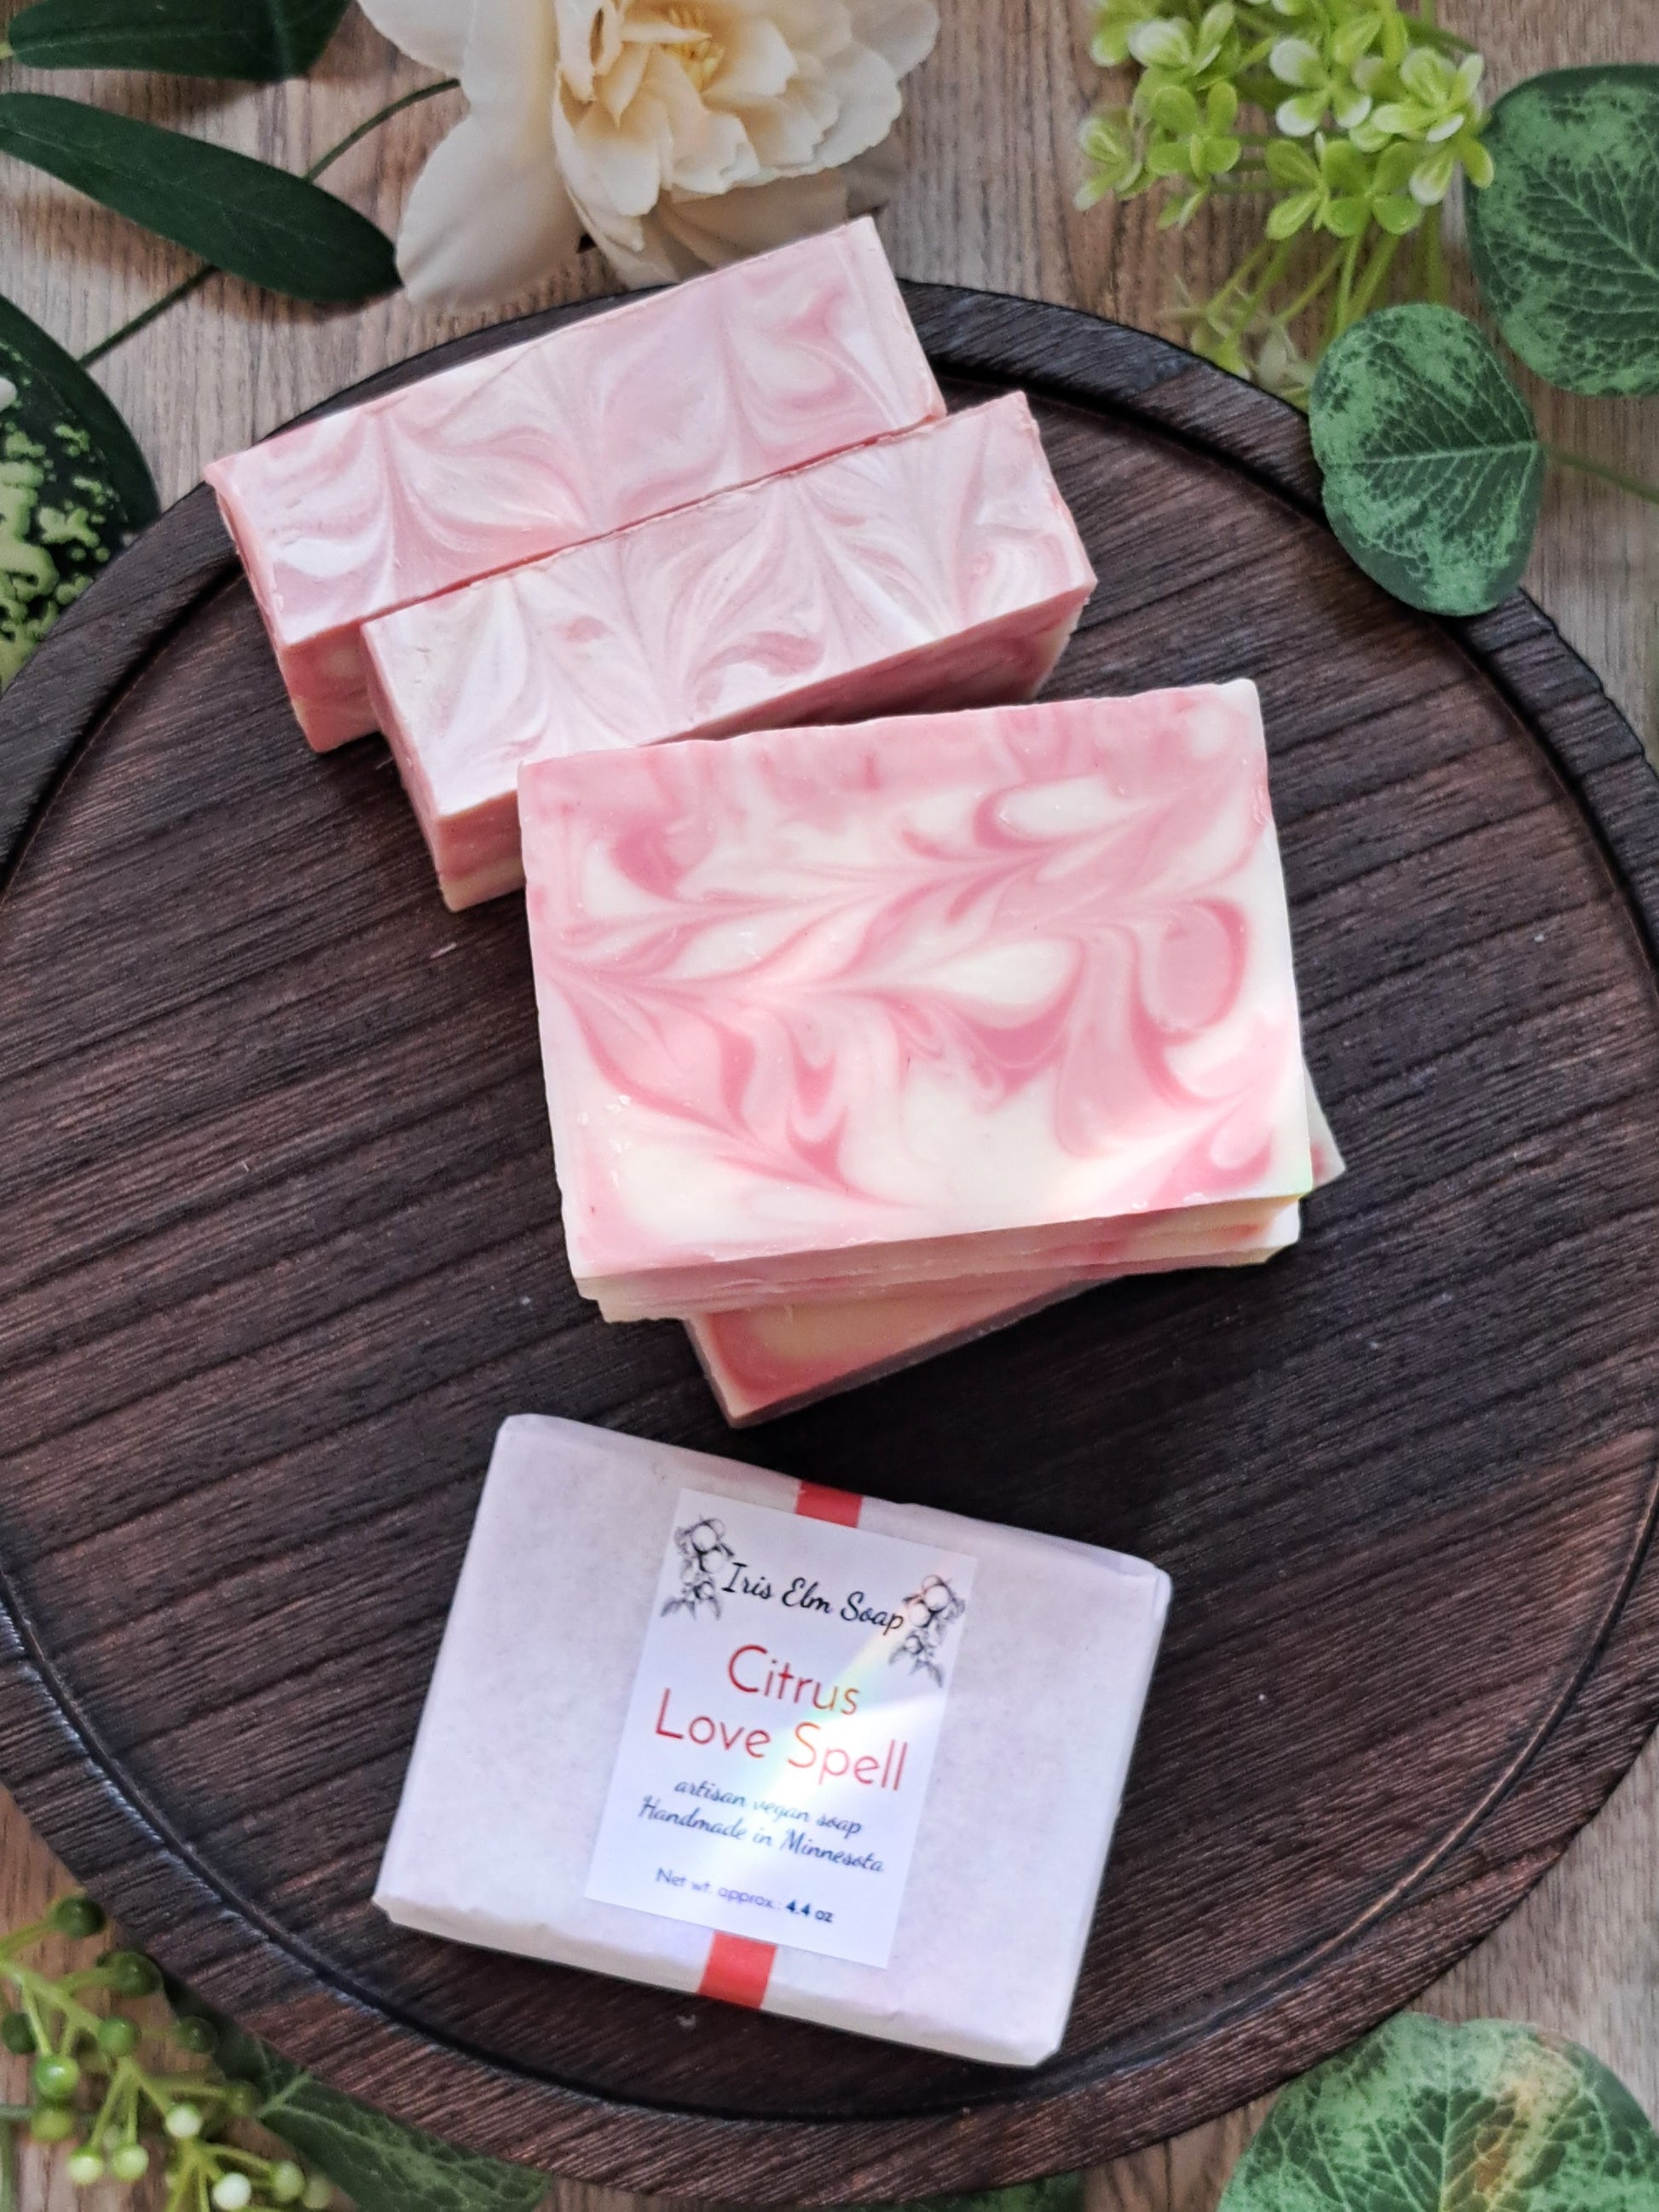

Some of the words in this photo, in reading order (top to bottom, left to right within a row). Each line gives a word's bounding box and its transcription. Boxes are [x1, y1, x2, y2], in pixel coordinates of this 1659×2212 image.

[722, 1562, 773, 1600] Iris
[782, 1578, 832, 1614] Elm
[841, 1591, 905, 1635] Soap
[727, 1644, 860, 1716] Citrus
[655, 1688, 771, 1759] Love
[788, 1721, 909, 1791] Spell
[638, 1795, 748, 1840] Handmade
[753, 1827, 772, 1846] in
[779, 1828, 884, 1873] Minnesota
[673, 1780, 746, 1808] artisan
[753, 1799, 810, 1823] vegan
[817, 1813, 862, 1839] soap
[656, 1868, 686, 1887] Net
[692, 1879, 712, 1893] wt.
[785, 1899, 811, 1918] 4.4
[815, 1909, 834, 1923] oz
